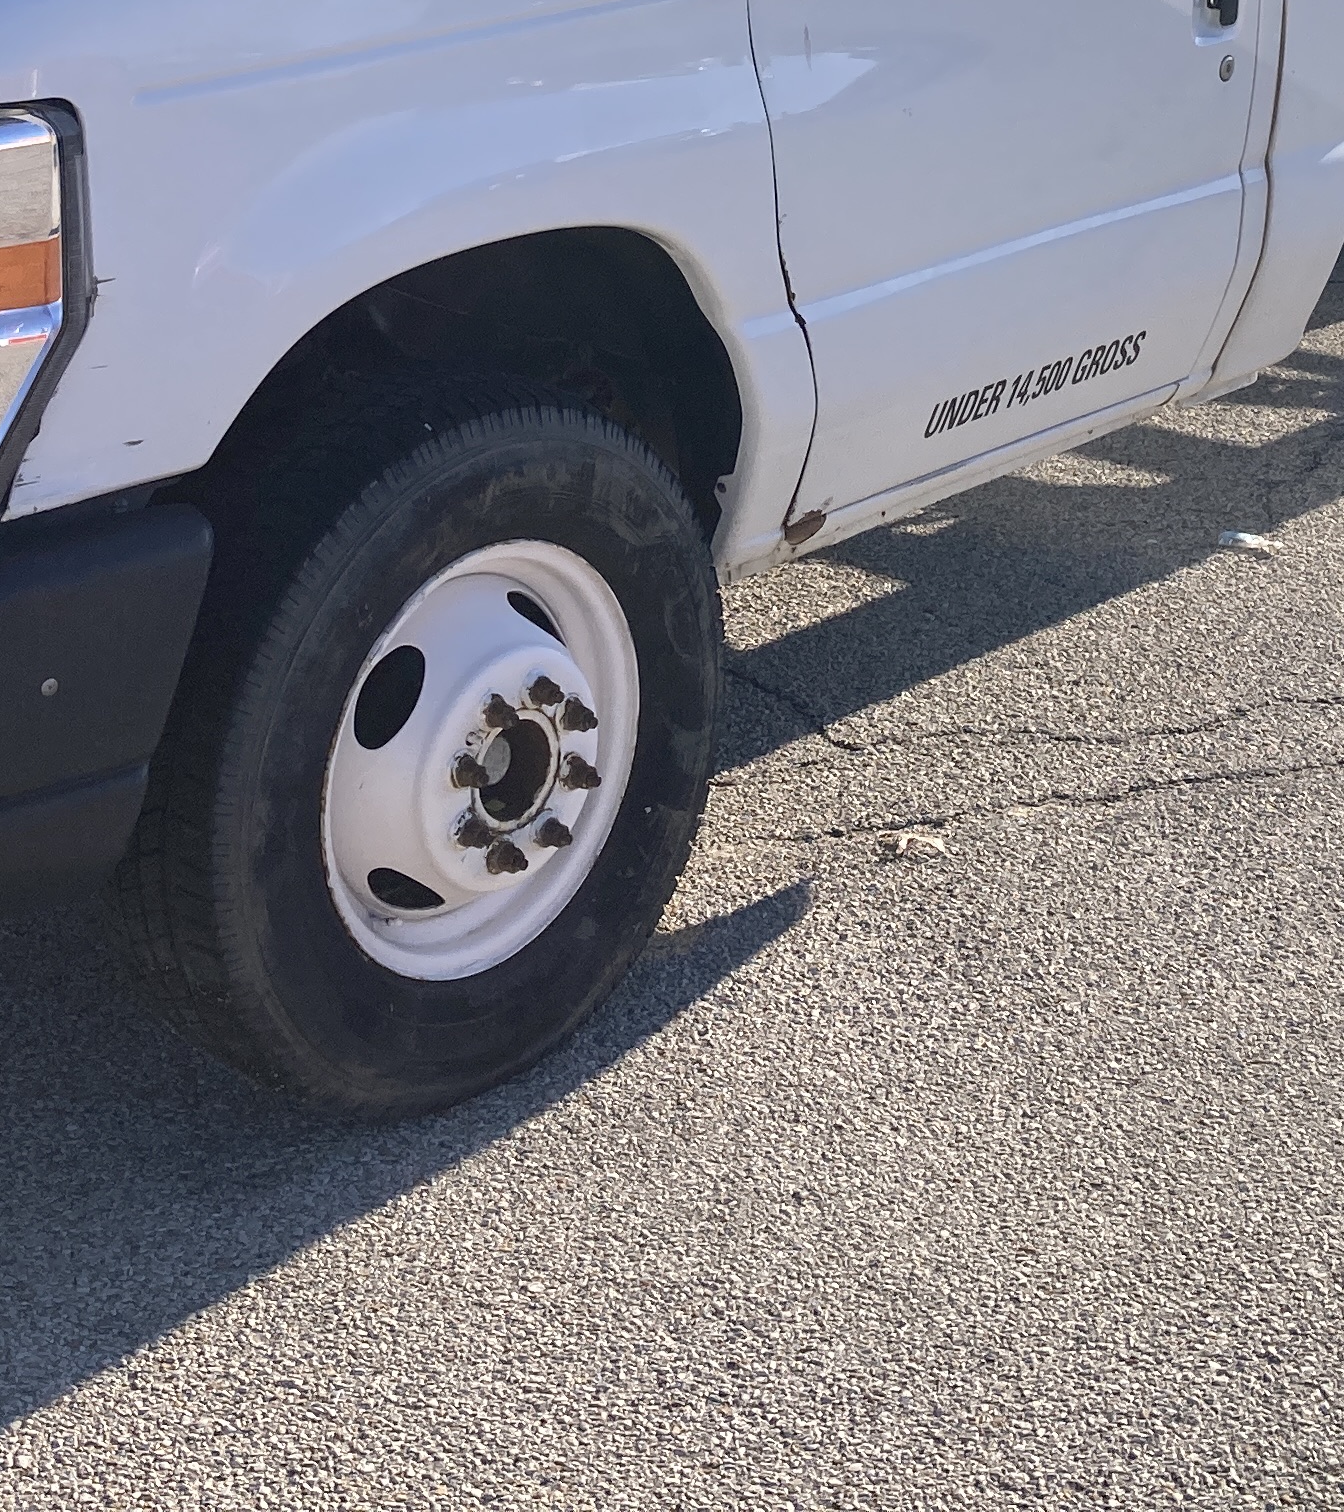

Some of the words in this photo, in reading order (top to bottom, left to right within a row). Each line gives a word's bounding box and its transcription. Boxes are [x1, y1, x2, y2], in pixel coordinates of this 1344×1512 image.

[923, 378, 1008, 439] UNDER
[1006, 355, 1074, 409] 14,500
[1071, 329, 1148, 386] GROSS
